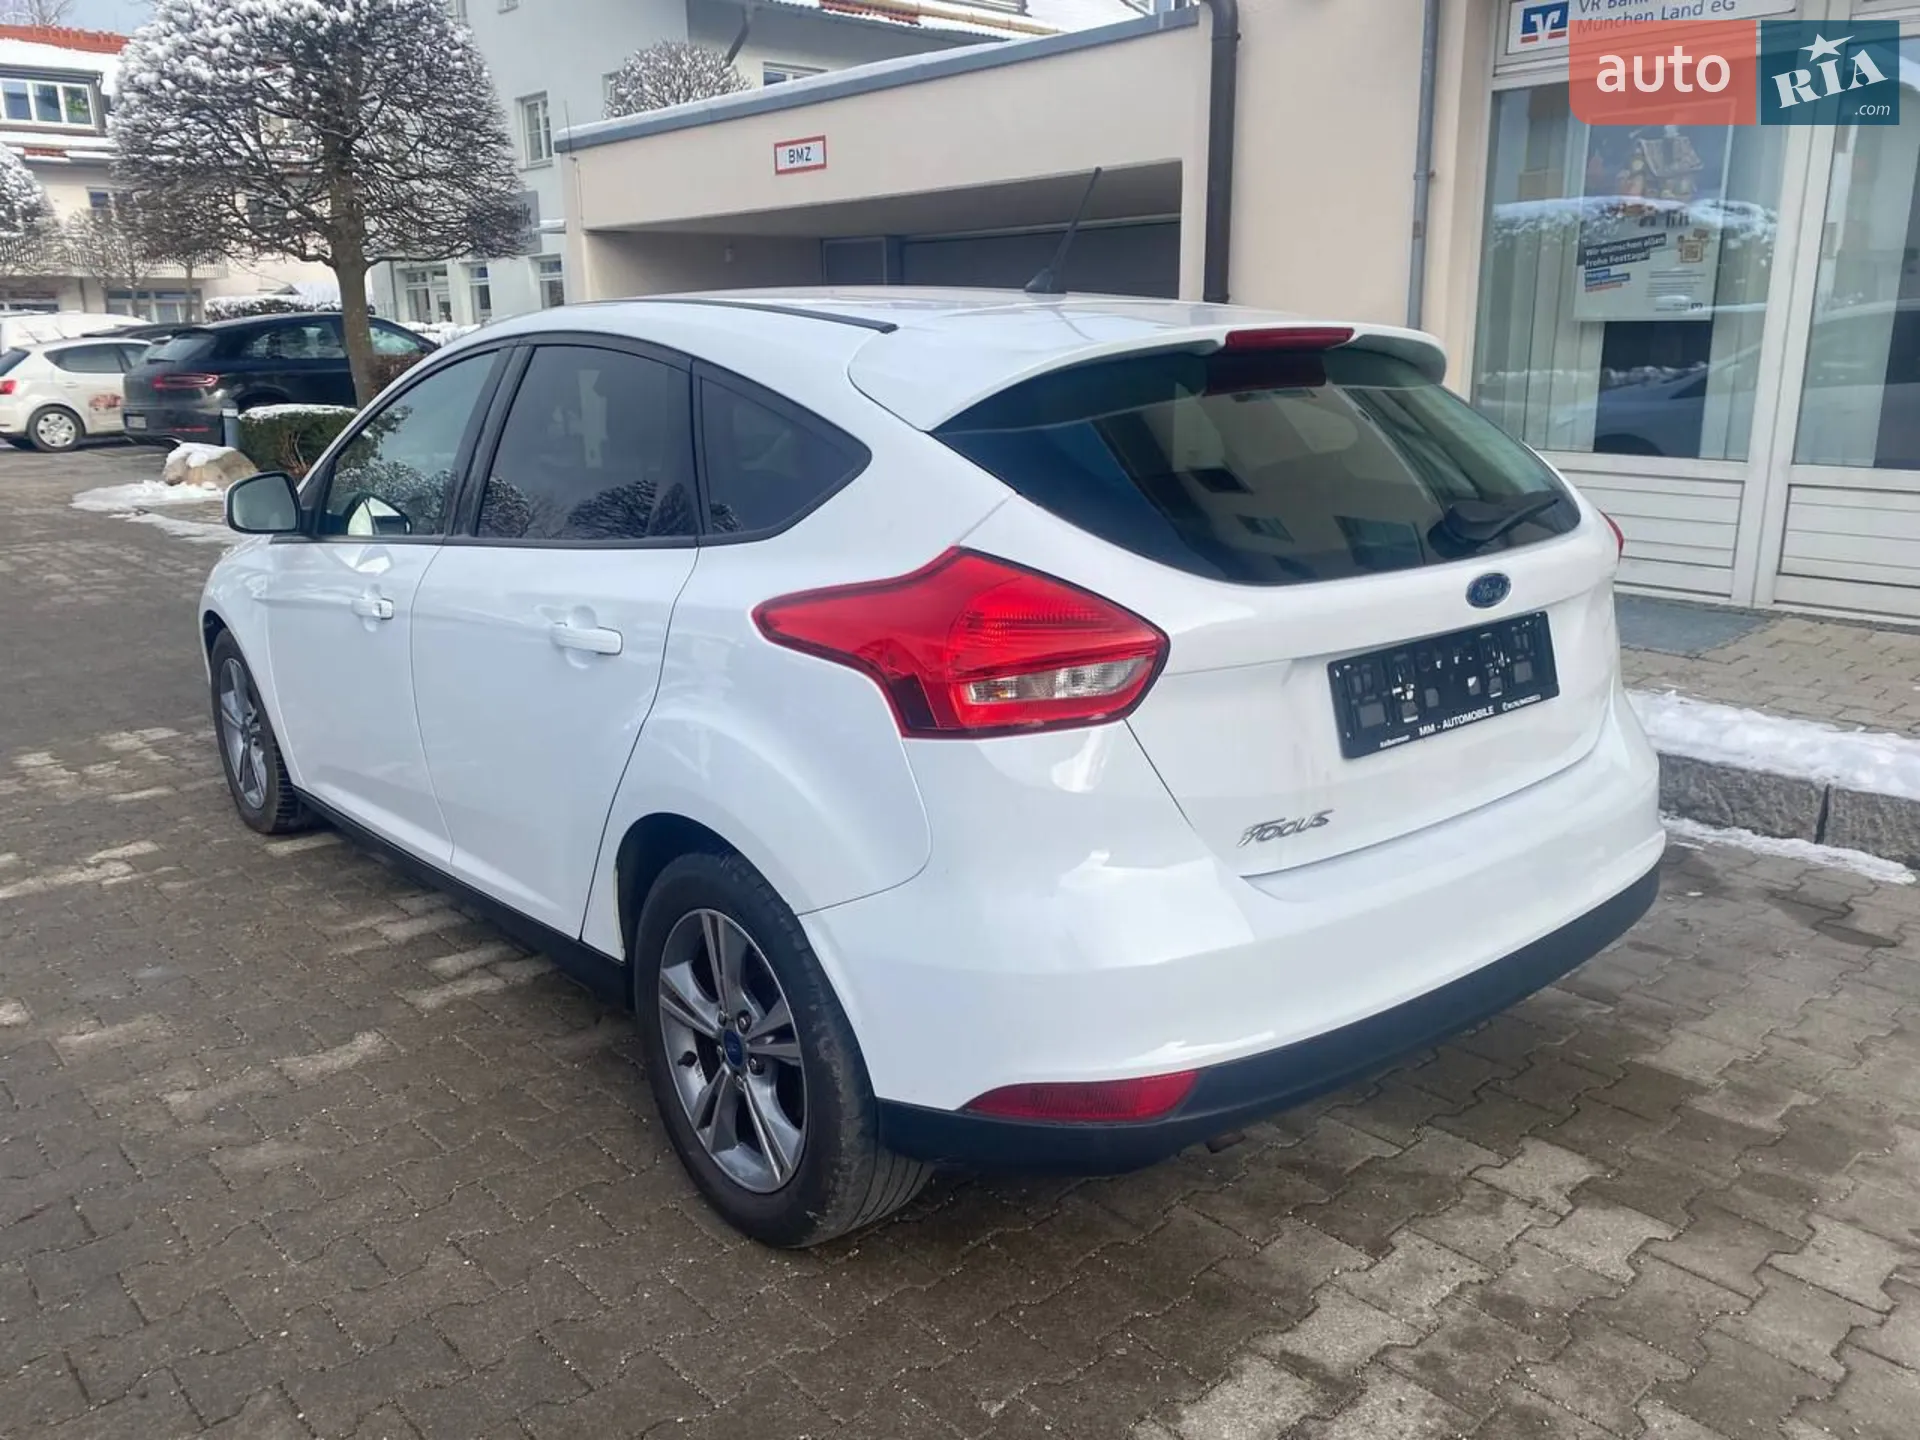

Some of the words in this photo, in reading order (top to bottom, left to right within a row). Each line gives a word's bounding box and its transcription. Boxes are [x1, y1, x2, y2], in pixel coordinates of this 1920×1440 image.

[1578, 11, 1654, 34] München
[1661, 0, 1705, 20] Land
[1711, 0, 1735, 12] eG
[1579, 0, 1600, 12] VR
[788, 146, 812, 164] BMZ
[1418, 723, 1436, 736] MM
[1442, 705, 1495, 730] AUTOMOBILE
